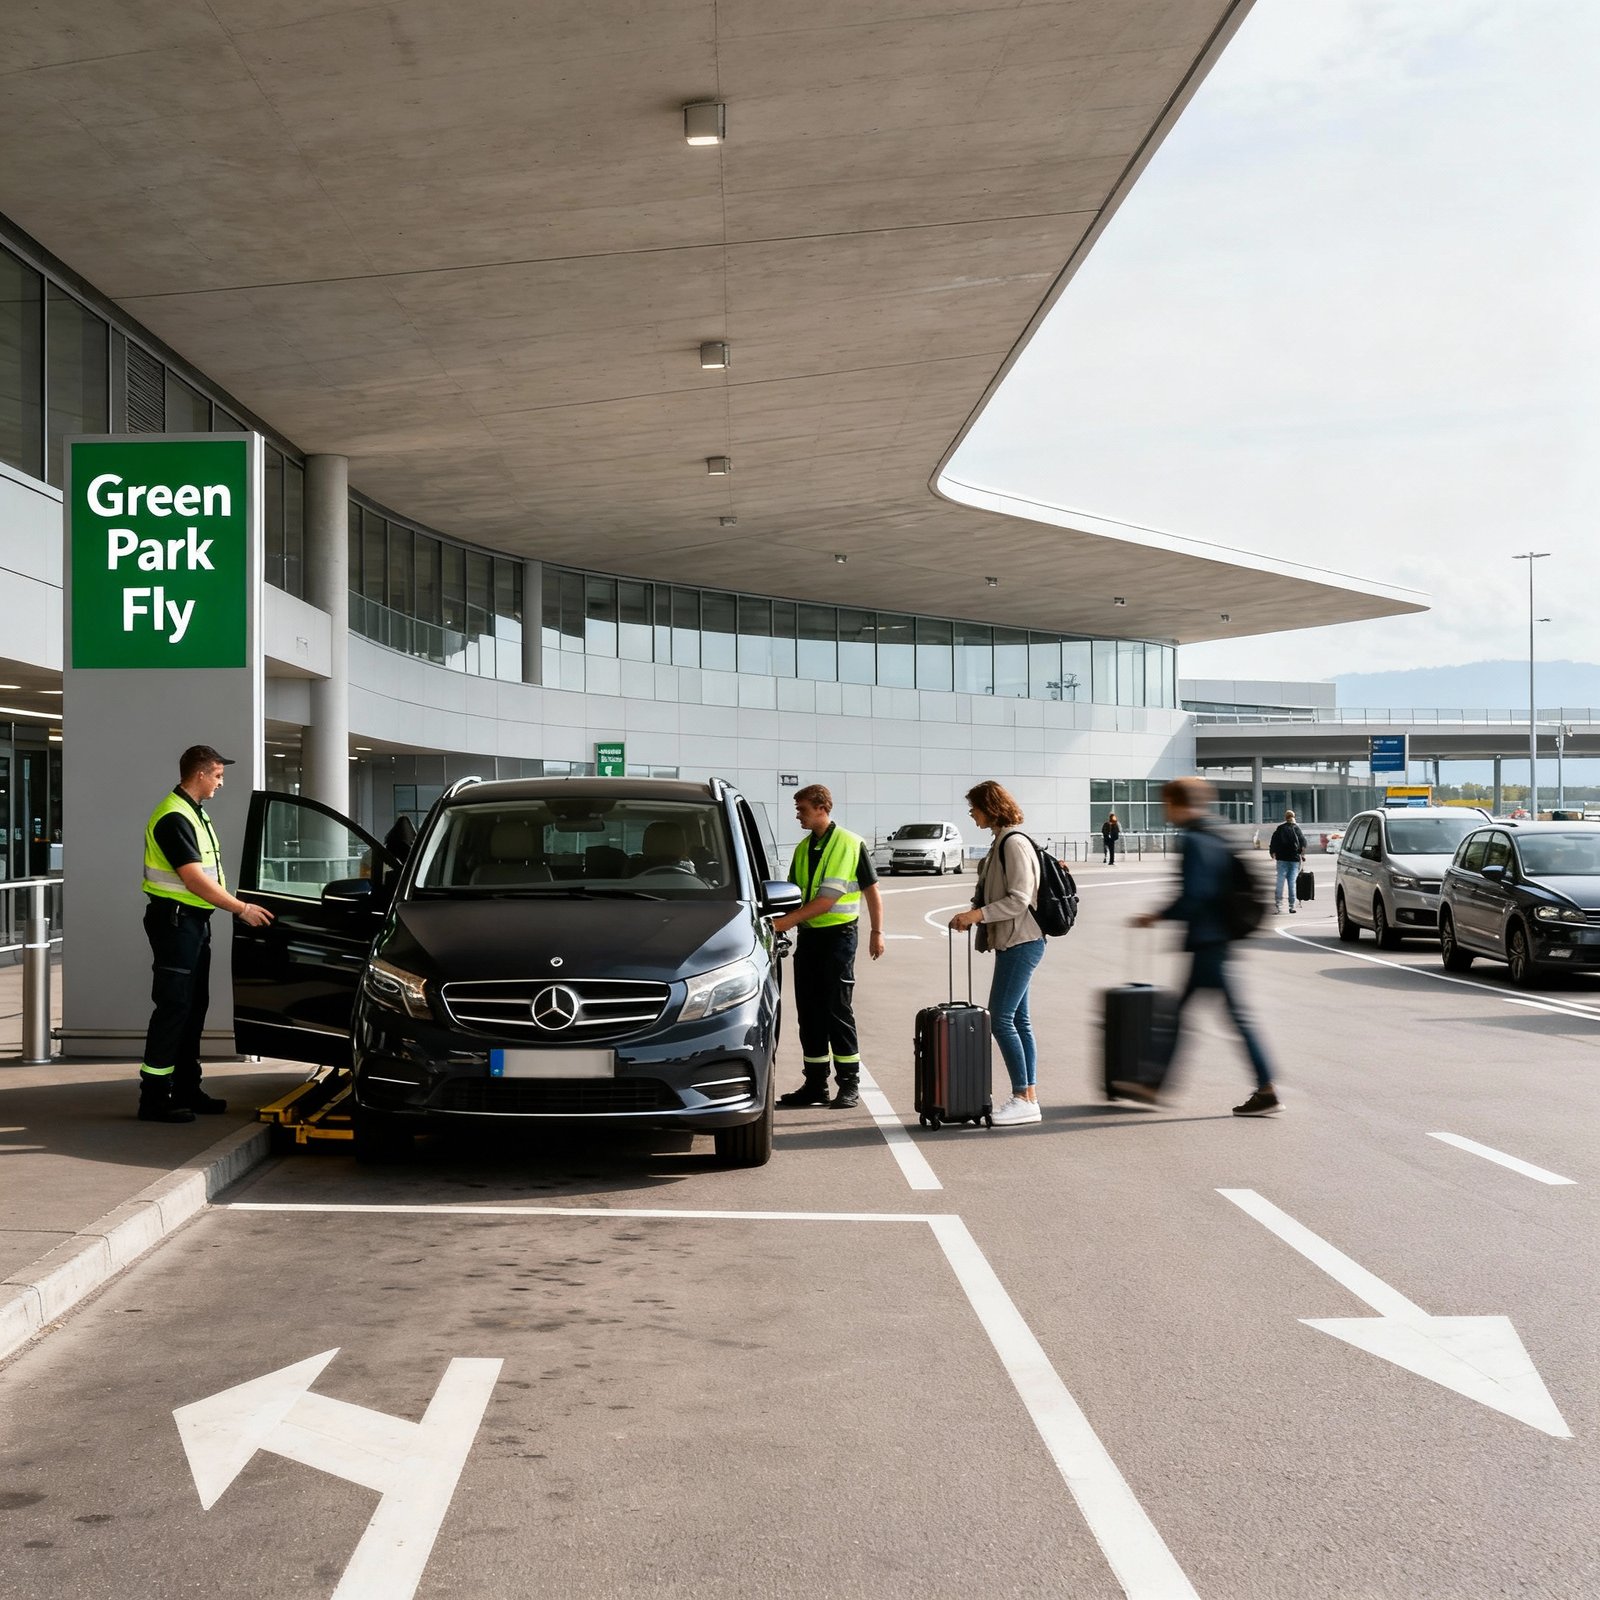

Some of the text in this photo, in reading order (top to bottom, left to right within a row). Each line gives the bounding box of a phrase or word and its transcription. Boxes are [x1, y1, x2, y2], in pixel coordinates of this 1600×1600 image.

[87, 474, 232, 517] Green
[107, 526, 215, 571] Park
[123, 586, 196, 643] Fly
